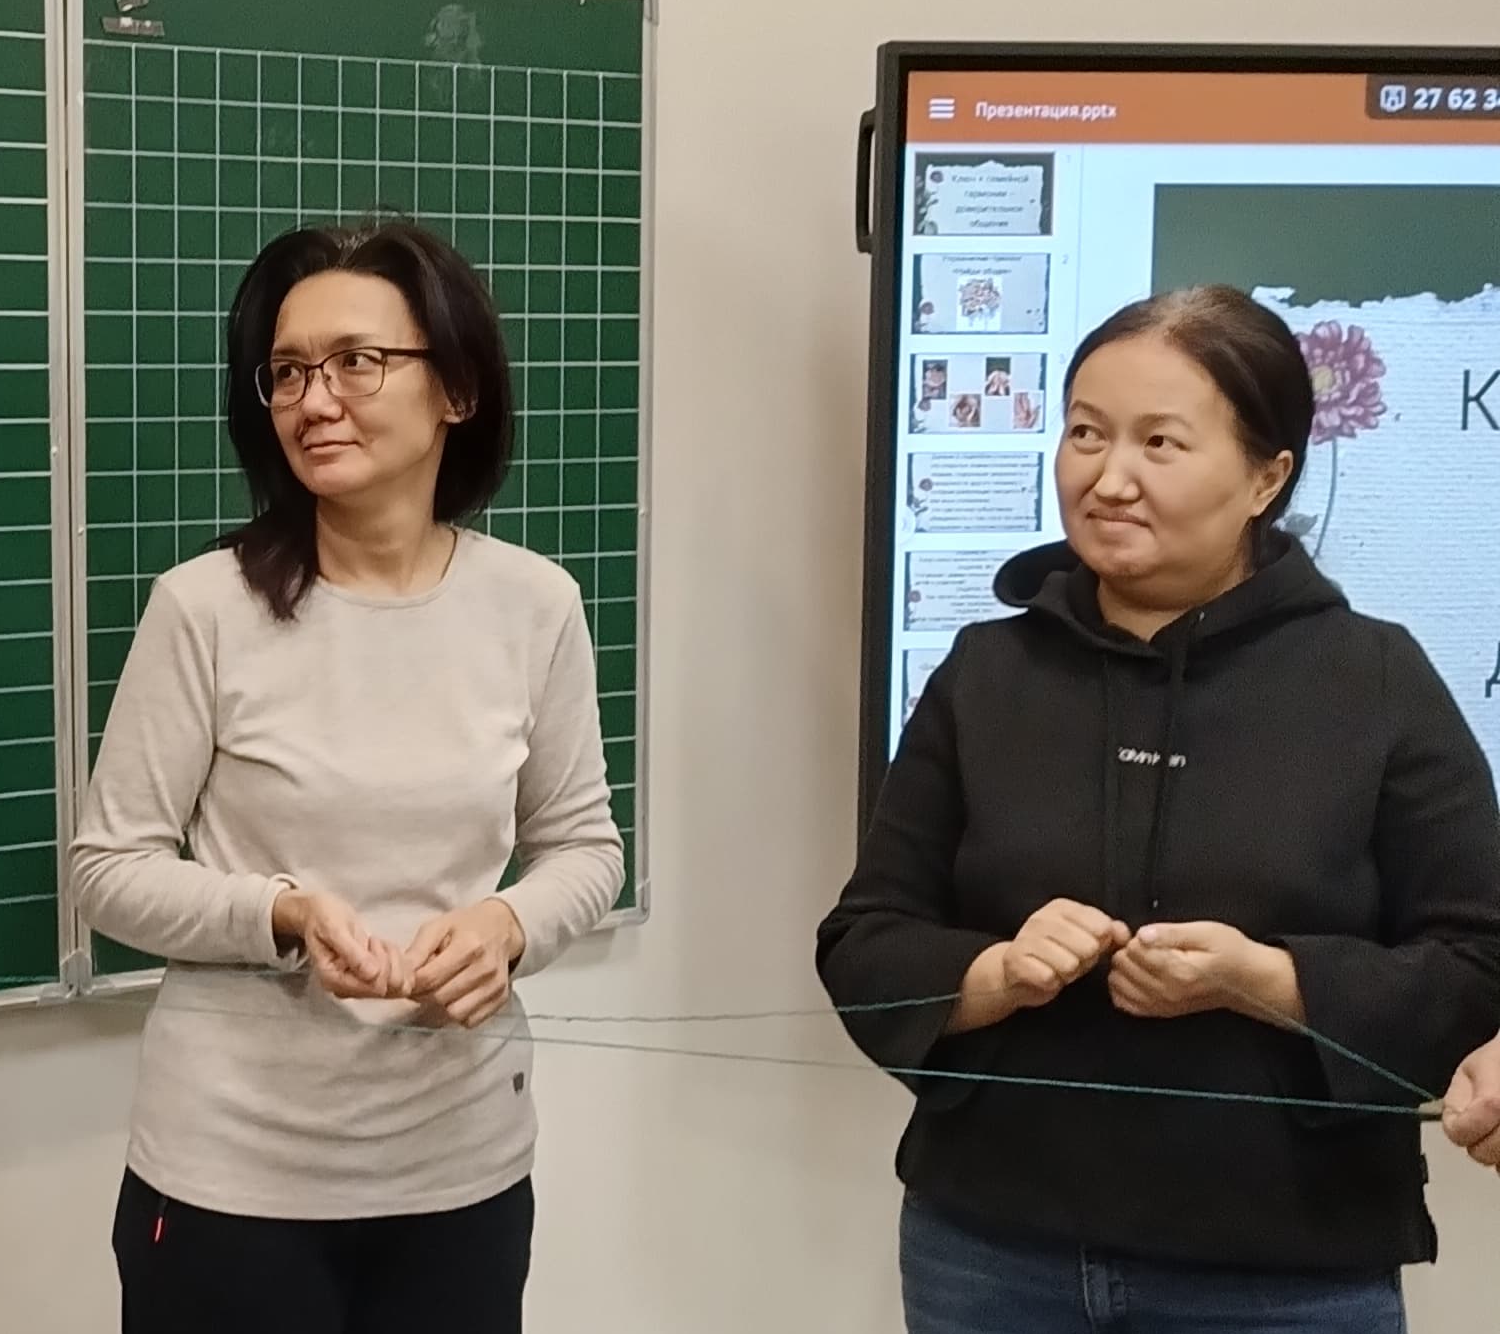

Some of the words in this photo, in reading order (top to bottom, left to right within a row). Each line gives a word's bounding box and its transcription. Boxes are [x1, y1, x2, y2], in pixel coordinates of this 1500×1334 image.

[1412, 86, 1443, 111] 27
[1447, 87, 1478, 111] 62
[1481, 87, 1500, 111] 3
[975, 100, 1117, 122] Презентация.pptx
